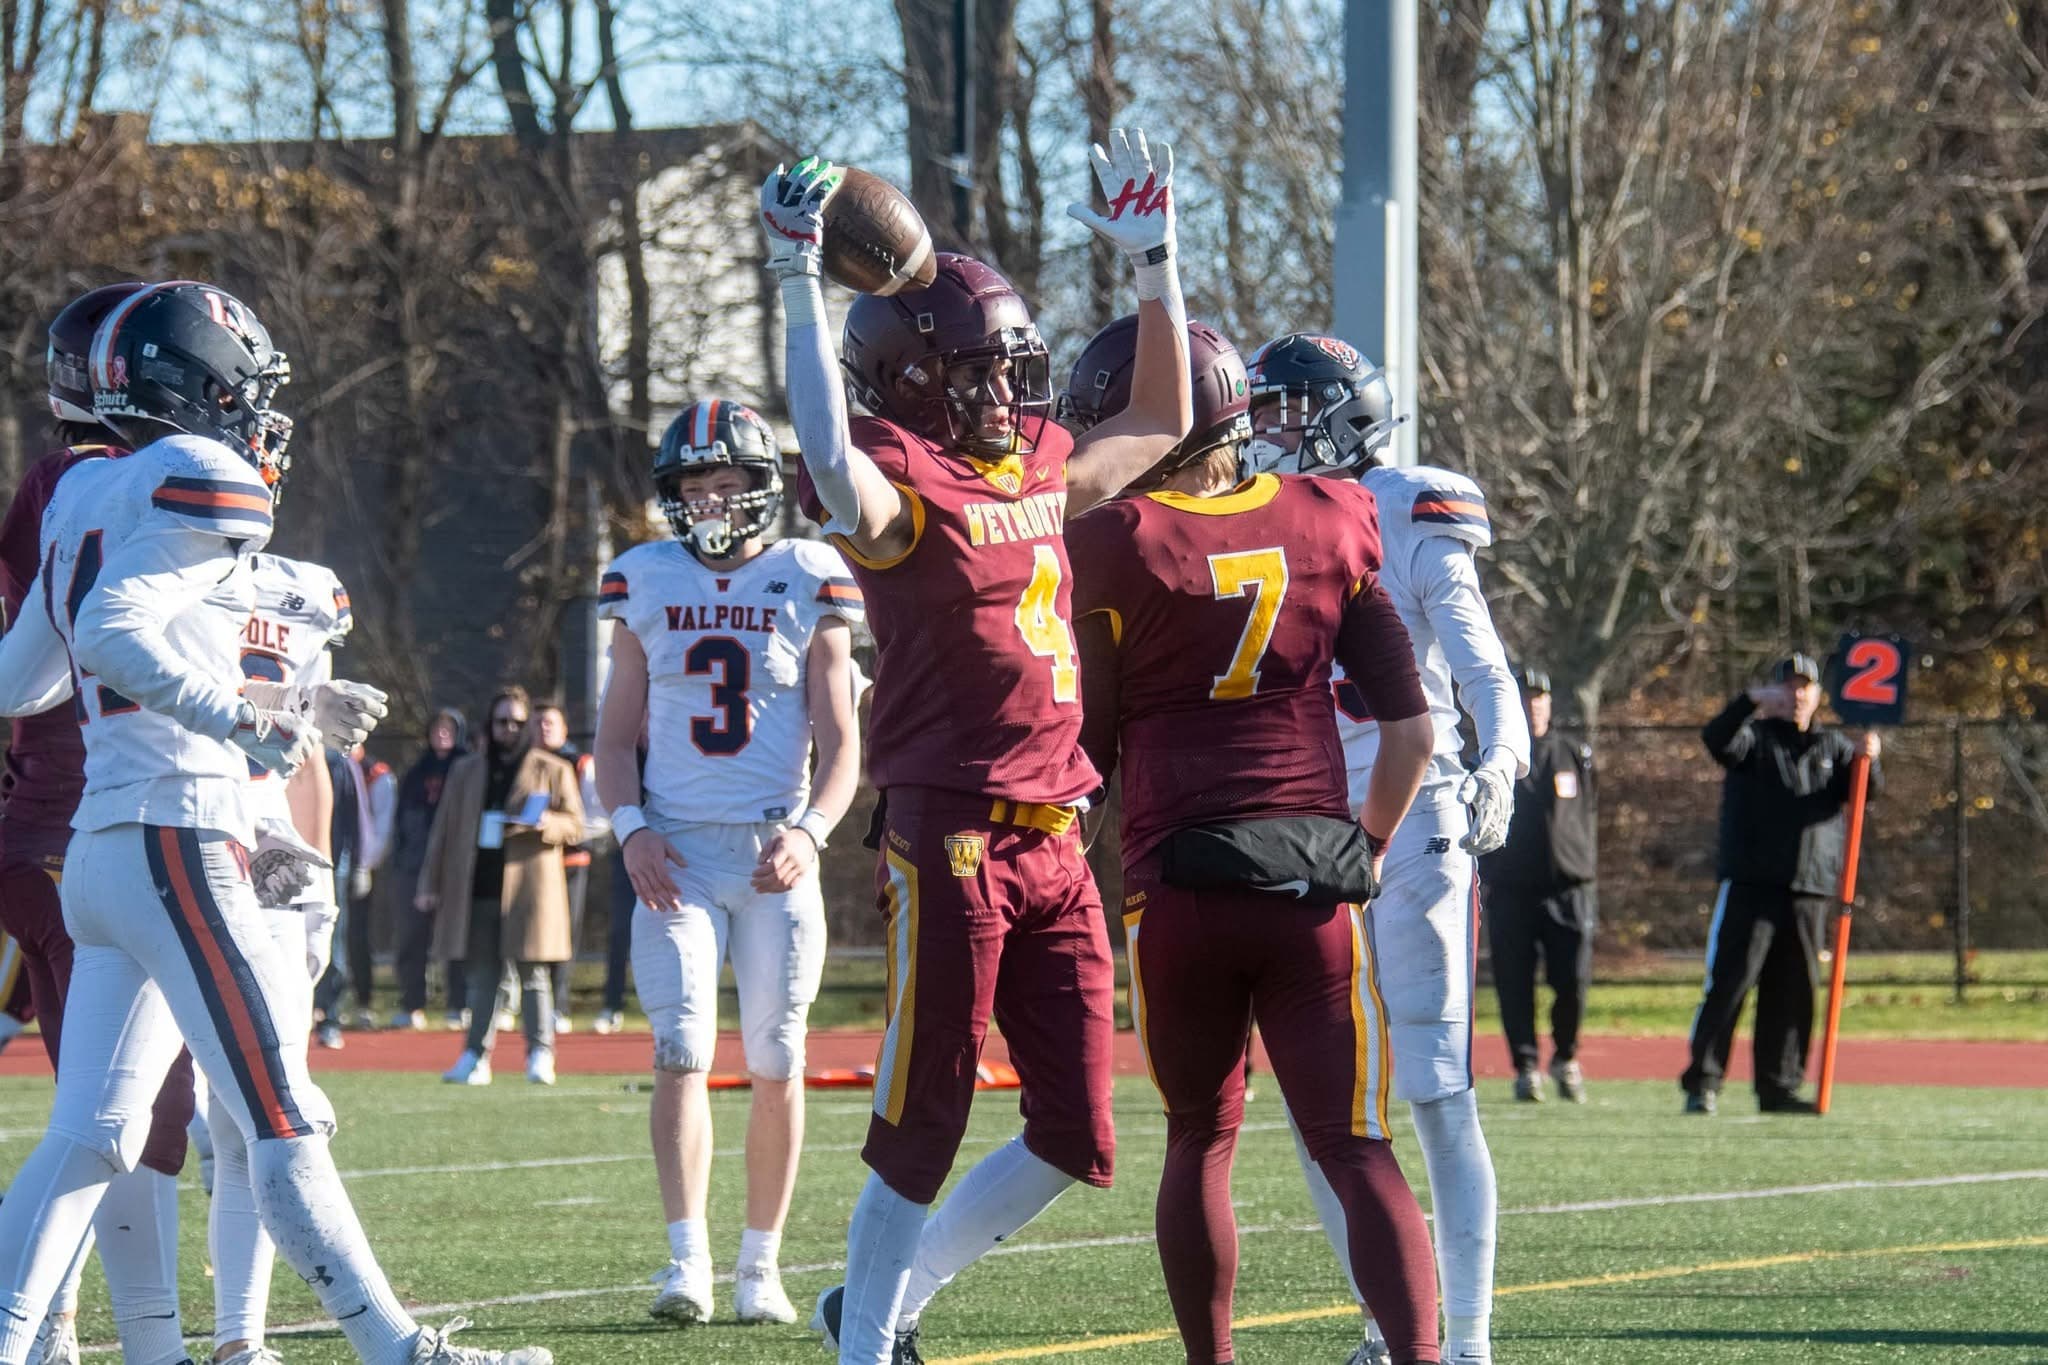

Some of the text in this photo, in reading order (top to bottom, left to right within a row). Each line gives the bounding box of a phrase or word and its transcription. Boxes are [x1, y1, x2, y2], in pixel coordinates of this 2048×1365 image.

[665, 604, 777, 633] WALPOLE
[1015, 545, 1078, 703] 4
[1207, 546, 1290, 701] 7
[1842, 638, 1900, 704] 2
[685, 636, 751, 757] 3
